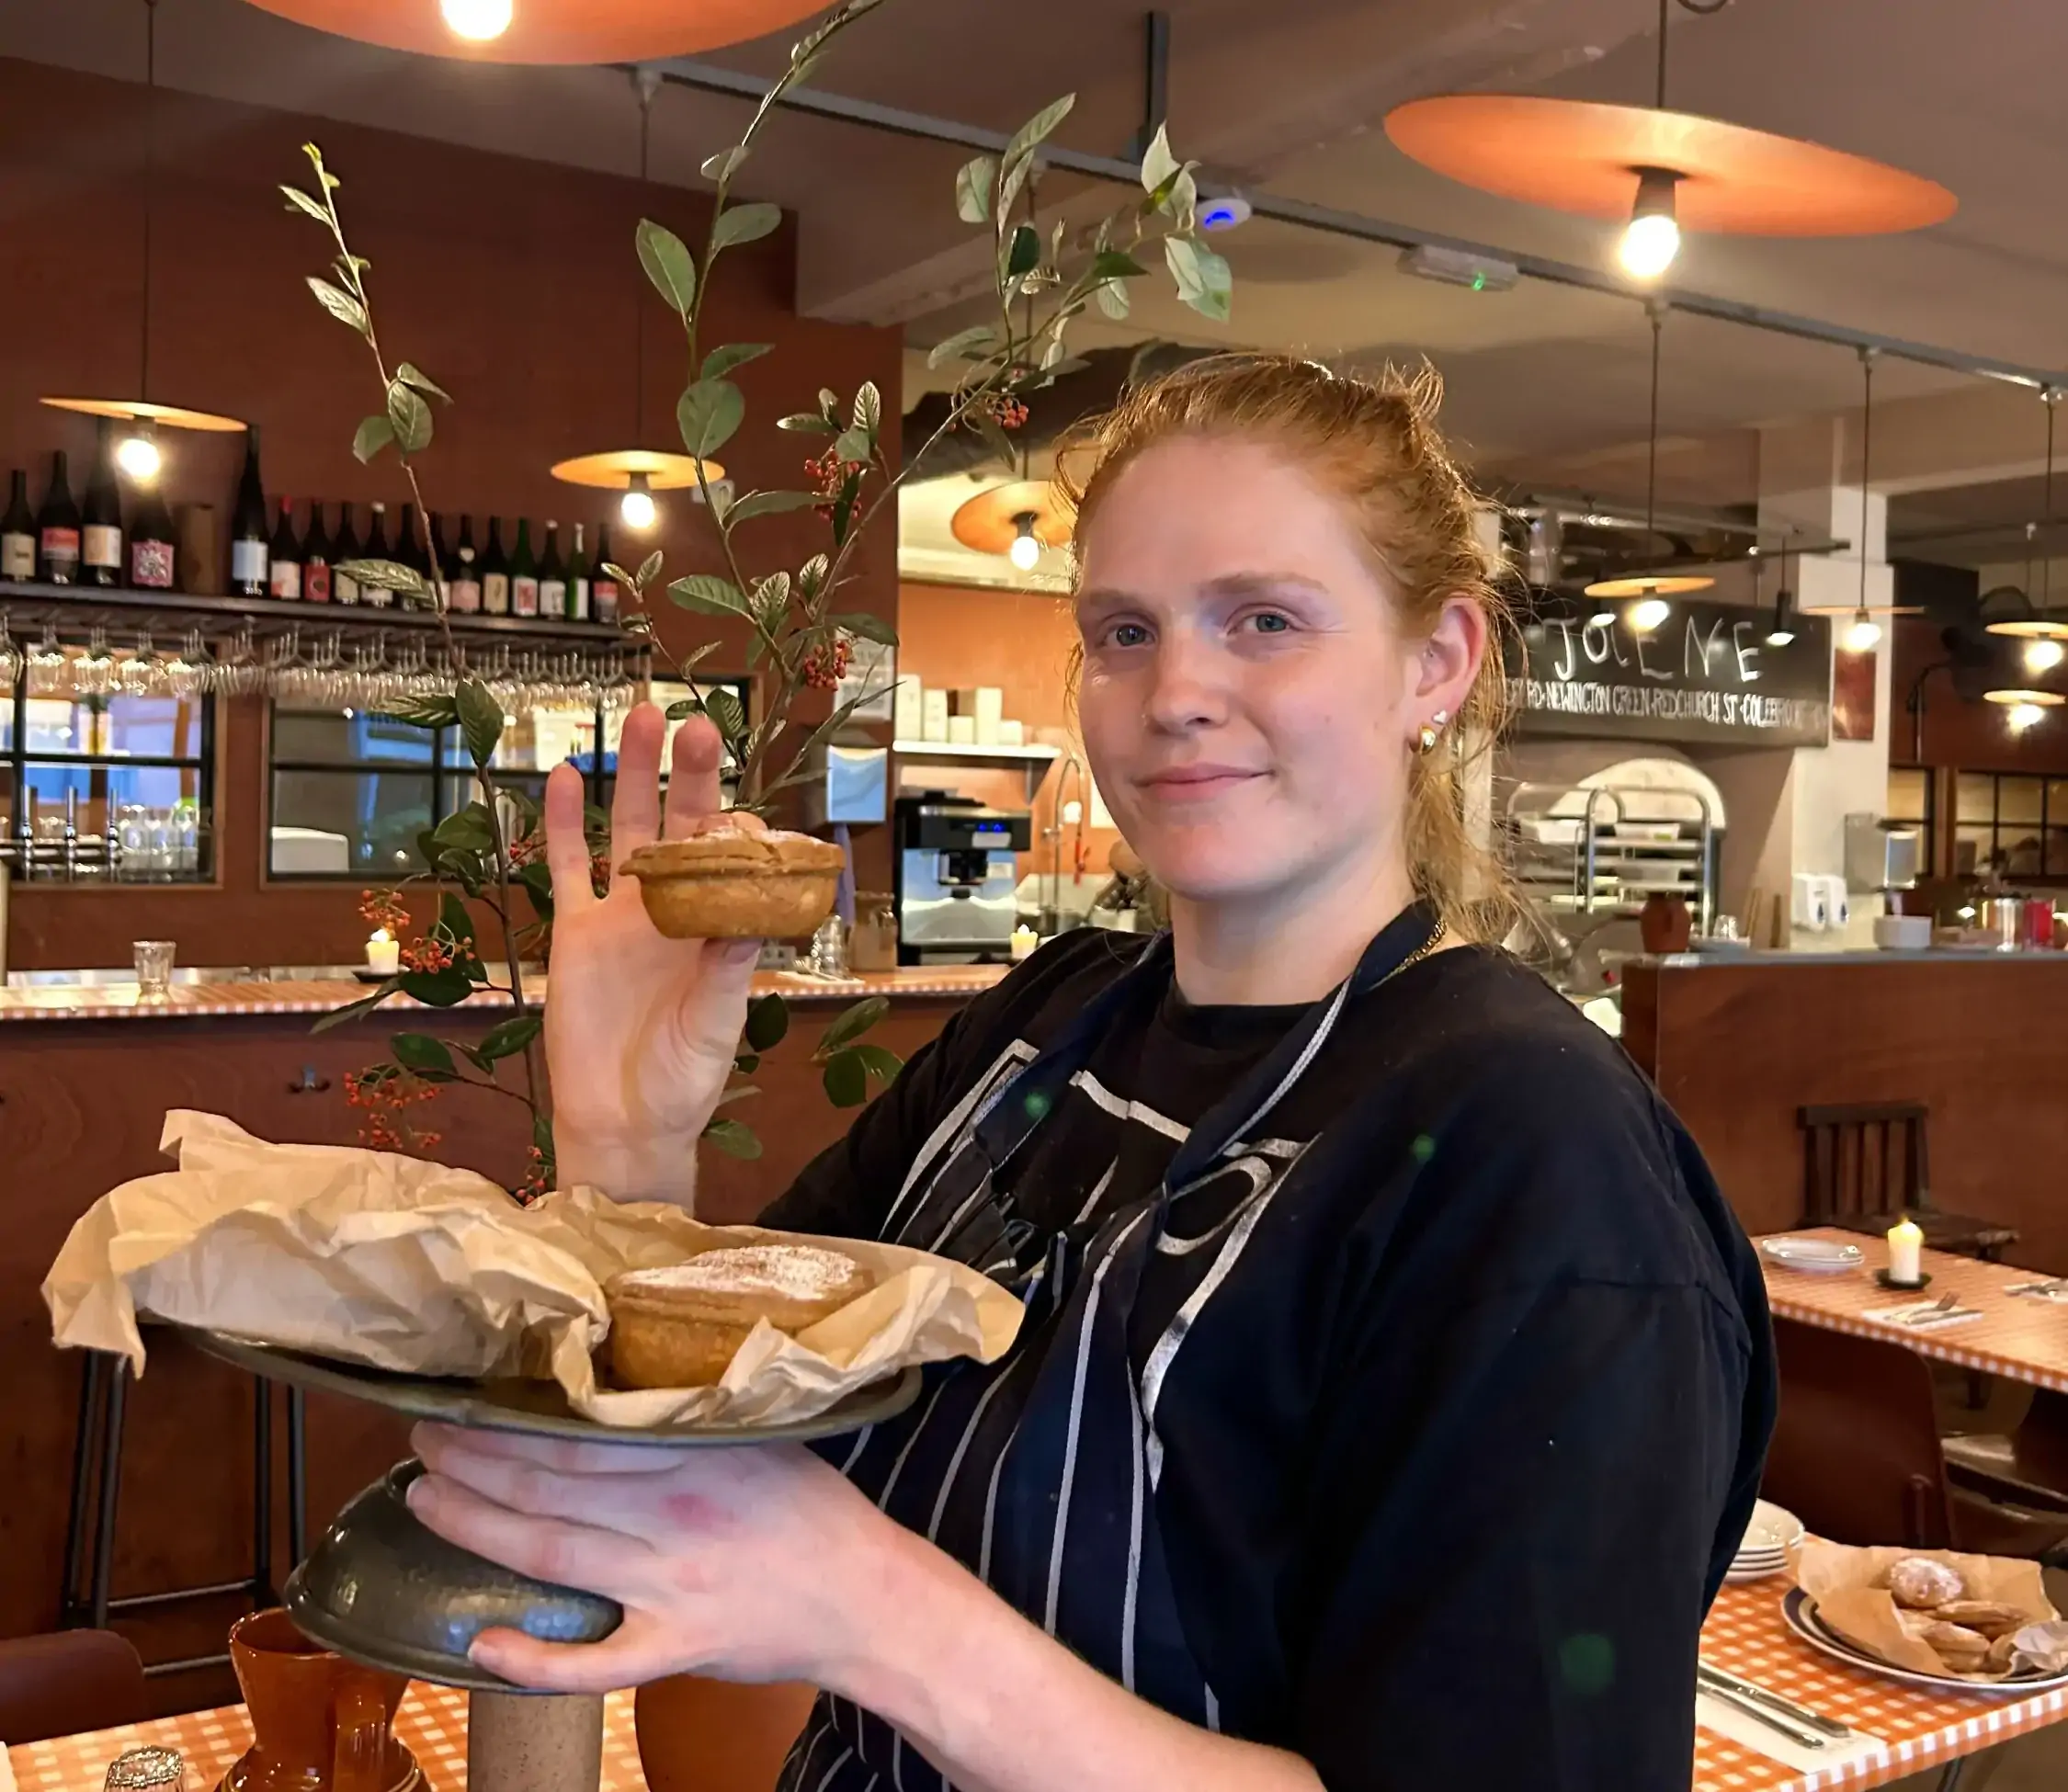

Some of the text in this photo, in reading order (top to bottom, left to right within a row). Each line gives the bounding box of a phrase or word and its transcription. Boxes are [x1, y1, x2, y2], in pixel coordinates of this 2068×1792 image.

[1542, 609, 1763, 682] JOLENE
[1546, 681, 1609, 714] NEWINGTON
[1613, 685, 1651, 718] GREEN
[1654, 687, 1720, 724] REDCHURCH
[1722, 692, 1739, 726] ST
